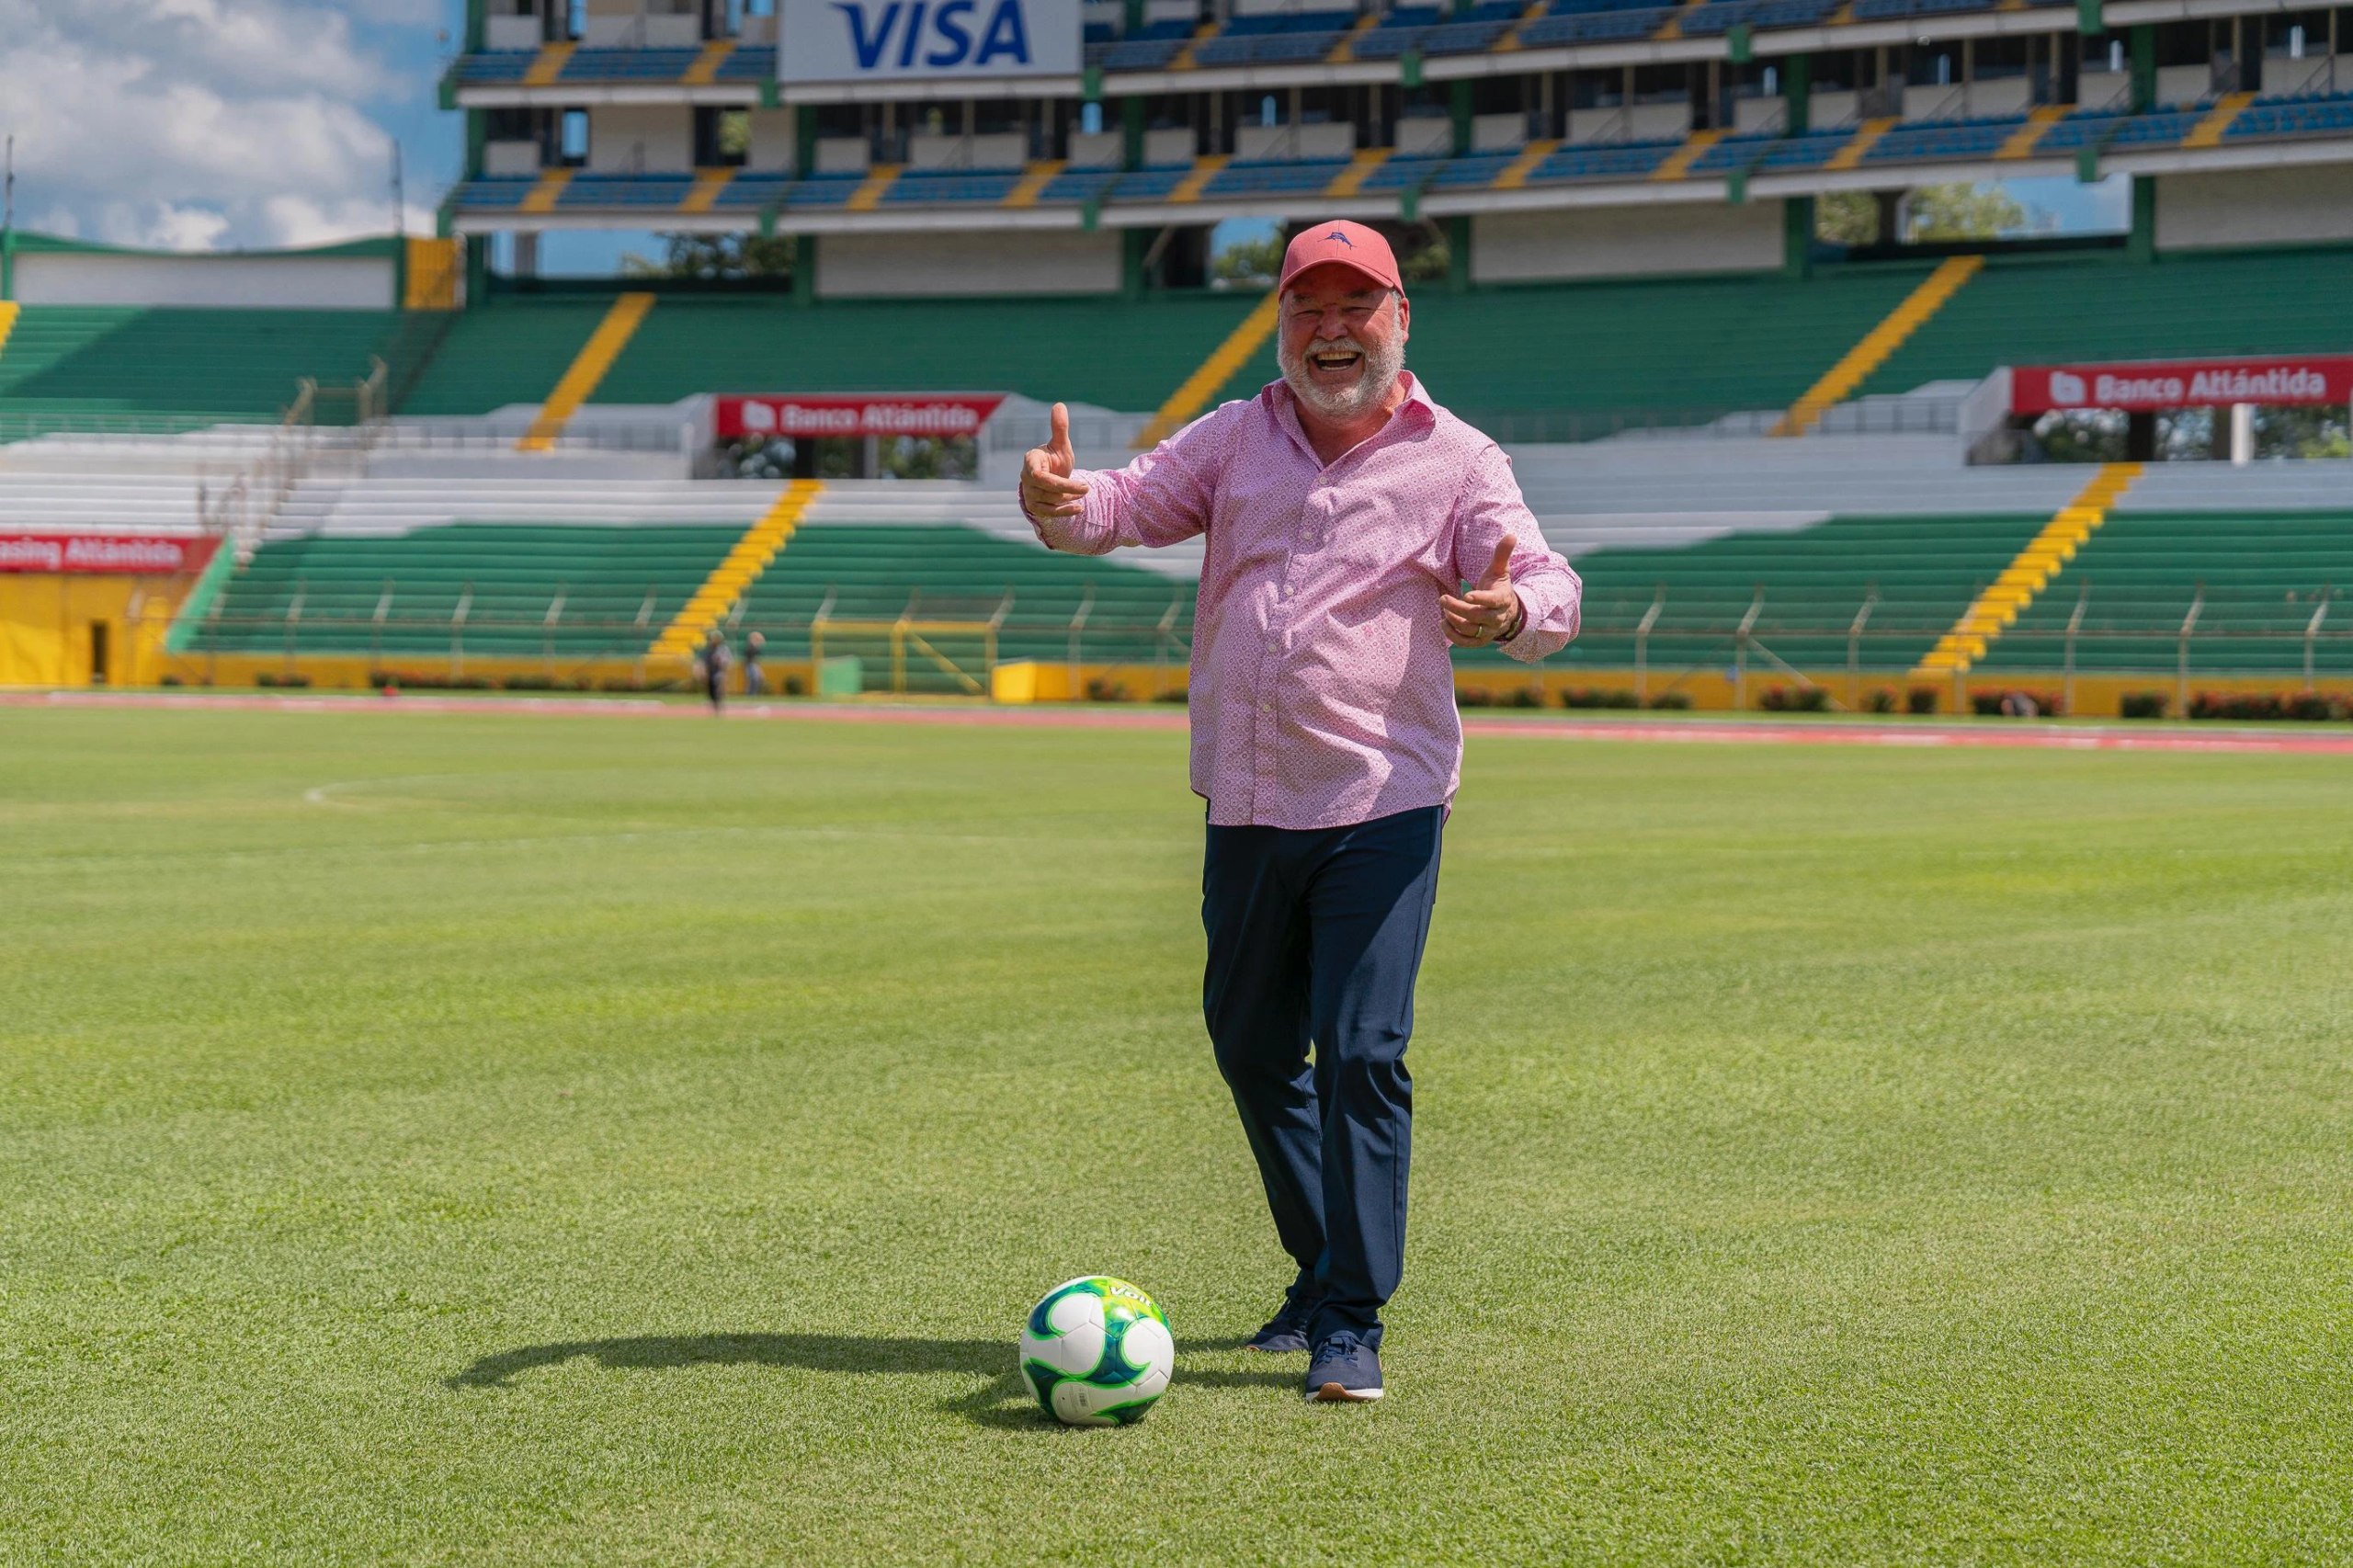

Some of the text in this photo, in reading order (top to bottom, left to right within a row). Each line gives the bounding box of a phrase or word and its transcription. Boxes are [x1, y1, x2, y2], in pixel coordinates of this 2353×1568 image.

[831, 0, 1032, 68] VISA
[2095, 368, 2326, 402] Banco Atlántida
[781, 402, 979, 430] Banco Atlántida
